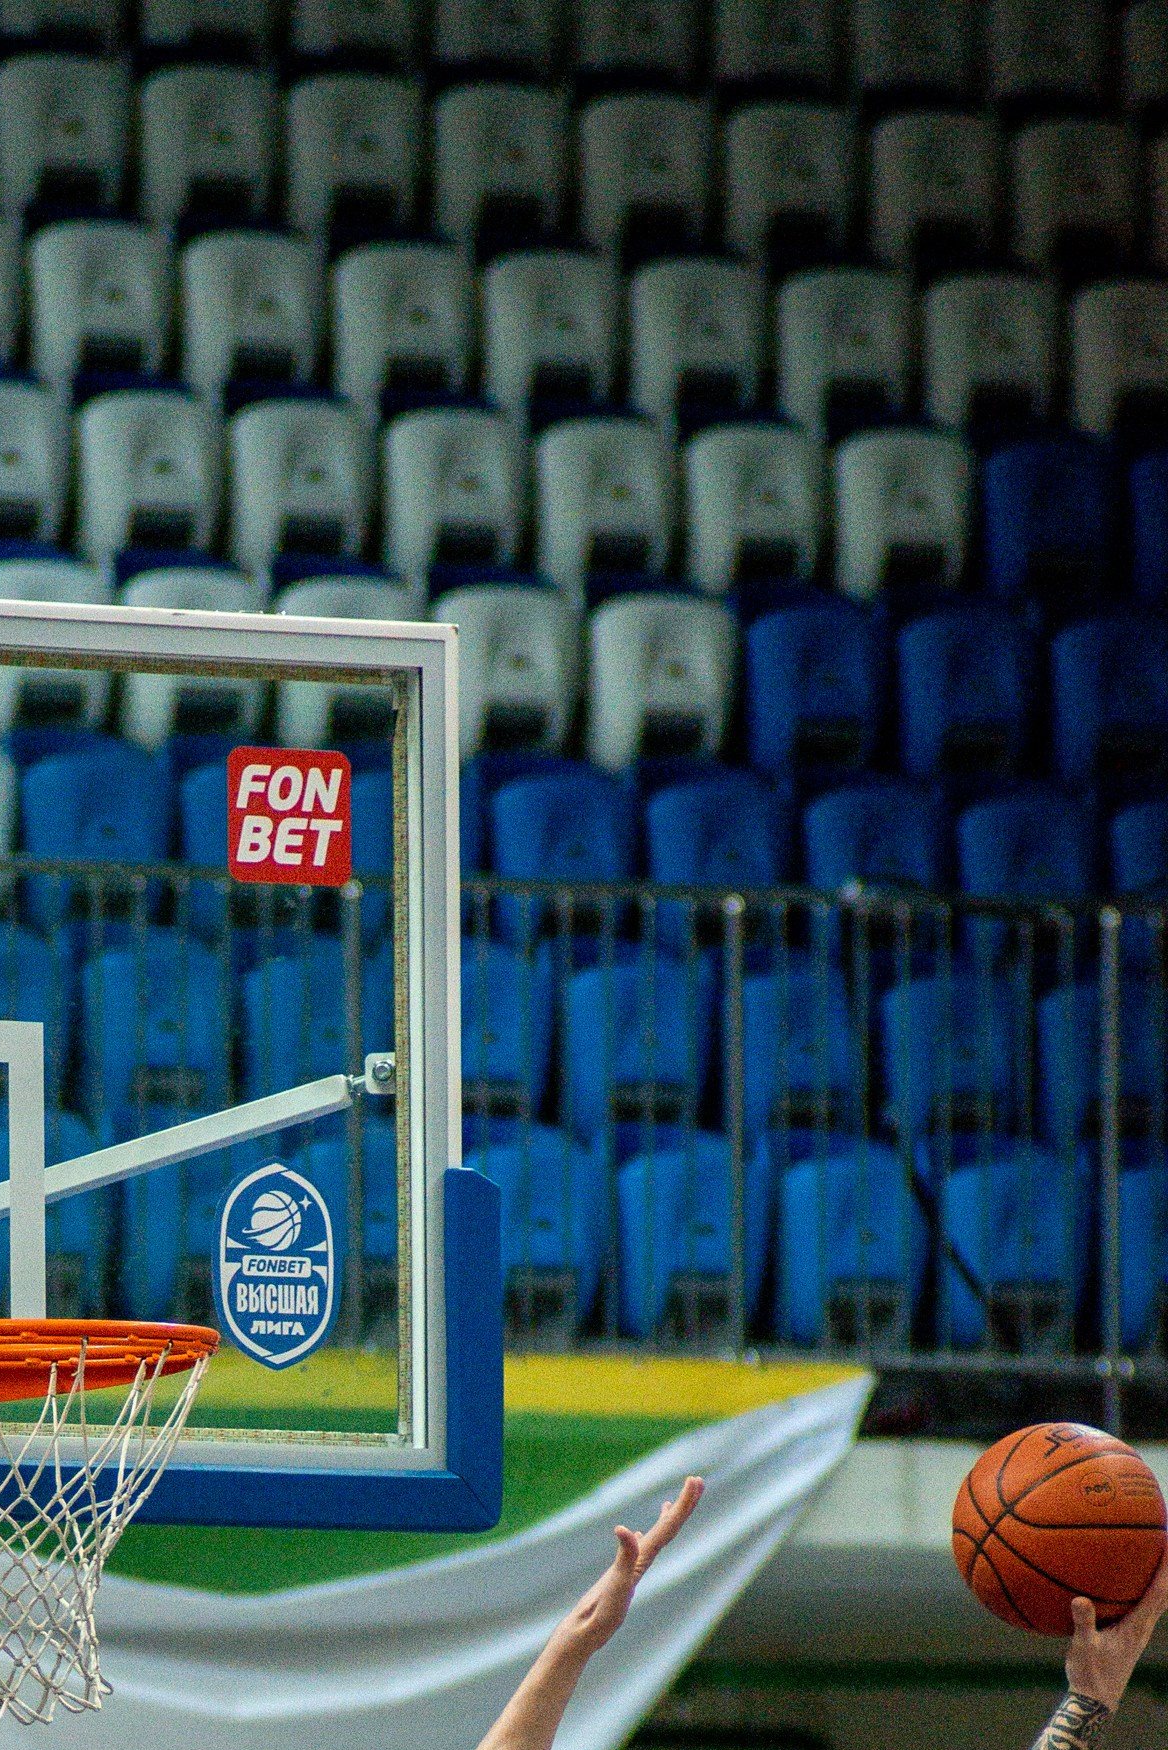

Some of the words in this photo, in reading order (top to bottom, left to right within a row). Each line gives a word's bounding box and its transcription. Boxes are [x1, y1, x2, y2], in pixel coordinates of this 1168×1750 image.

[236, 764, 343, 813] FON
[236, 815, 344, 867] BET
[247, 1258, 307, 1274] FONBET
[236, 1283, 319, 1315] ВЫСШАЯ
[250, 1320, 306, 1336] ЛИГА
